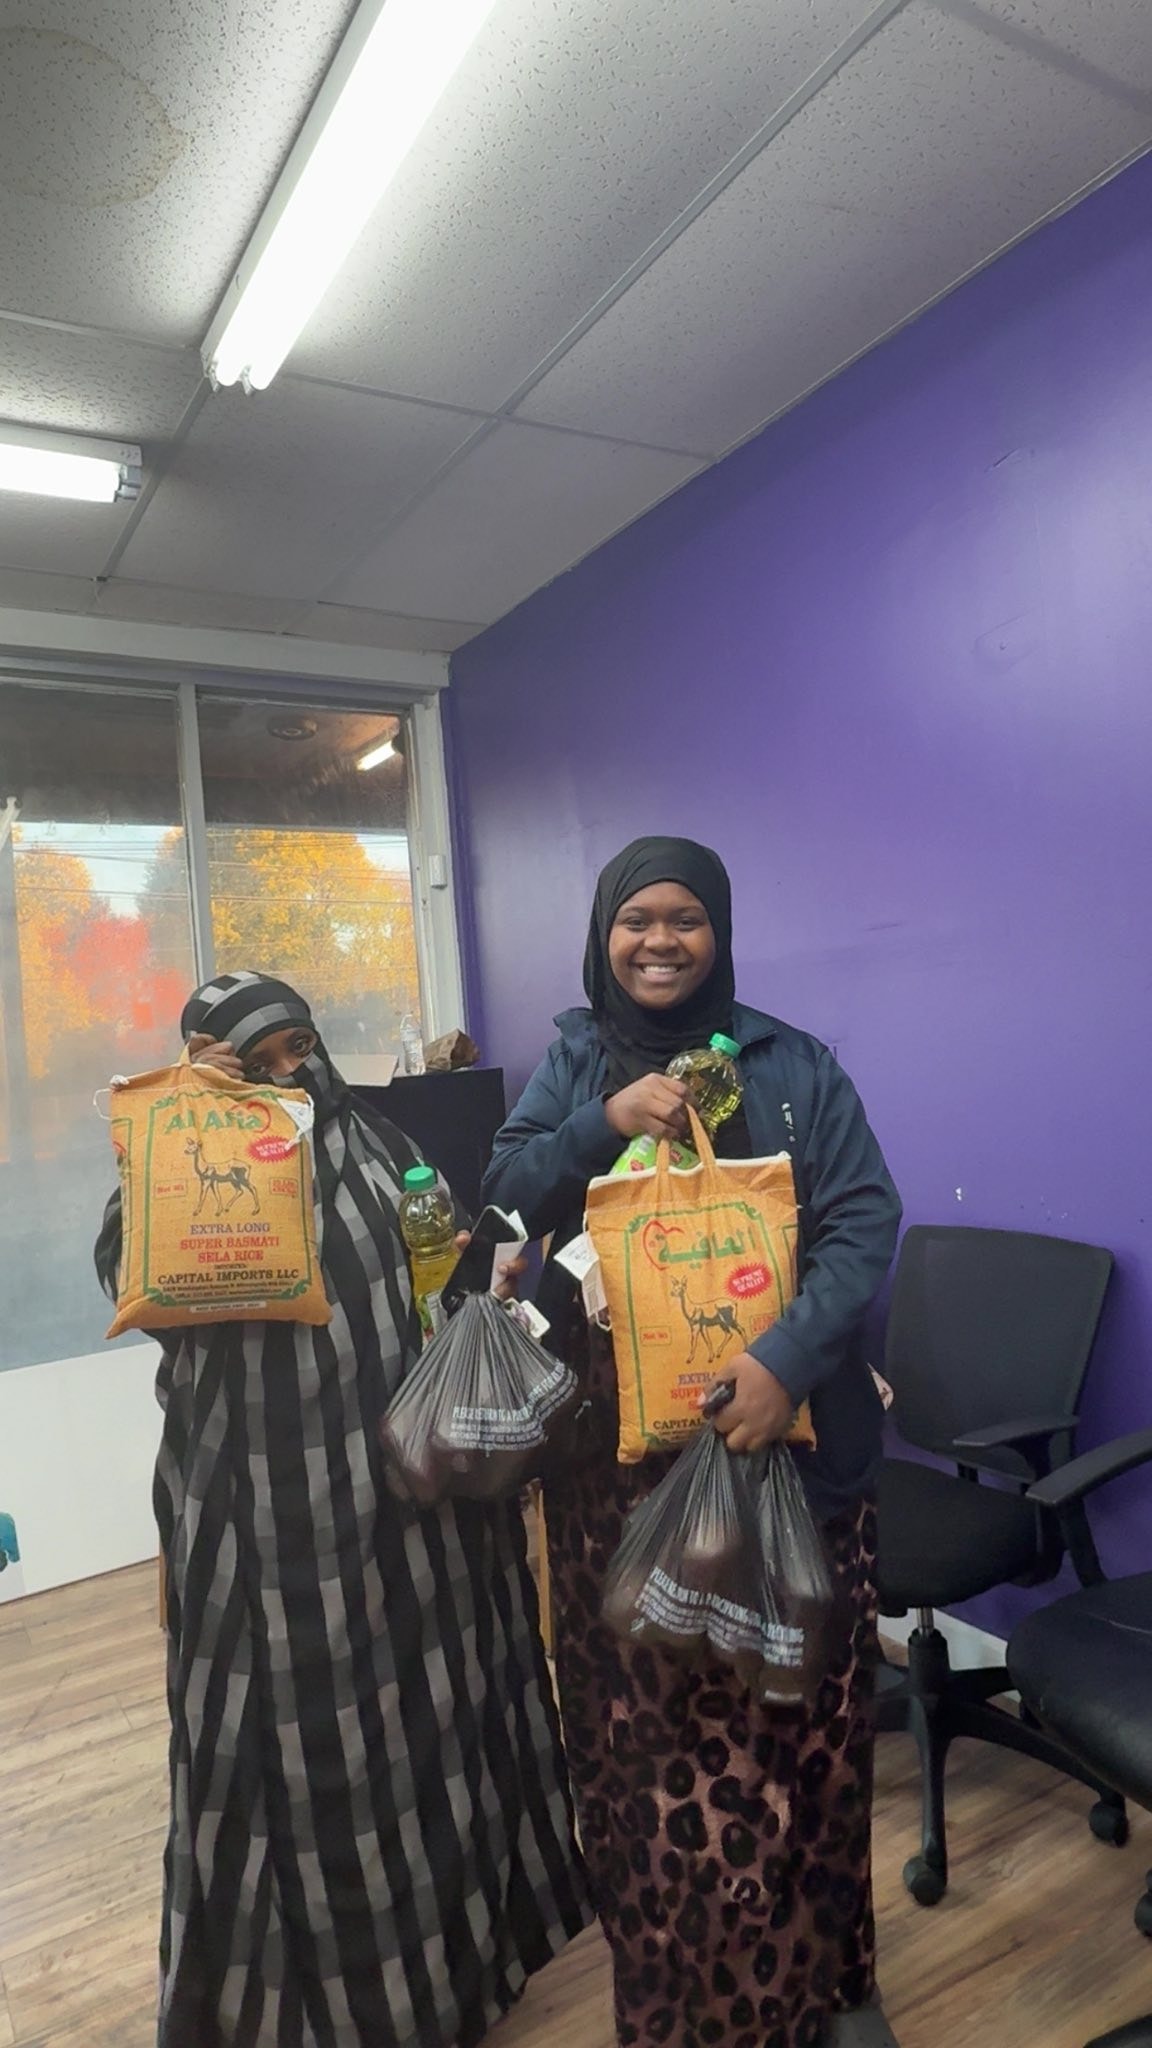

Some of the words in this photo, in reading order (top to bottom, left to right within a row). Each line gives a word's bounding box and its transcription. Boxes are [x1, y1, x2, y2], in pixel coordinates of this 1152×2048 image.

[190, 1223, 233, 1235] EXTRA
[236, 1222, 270, 1233] LONG
[180, 1238, 222, 1251] SUPER
[226, 1236, 280, 1248] BASMATI
[198, 1251, 230, 1264] SELA
[234, 1250, 264, 1261] RICE
[158, 1272, 213, 1285] CAPITAL
[216, 1270, 273, 1281] IMPORTS
[276, 1269, 299, 1279] LLC
[678, 1372, 716, 1385] EXTR
[671, 1386, 704, 1399] SUPE
